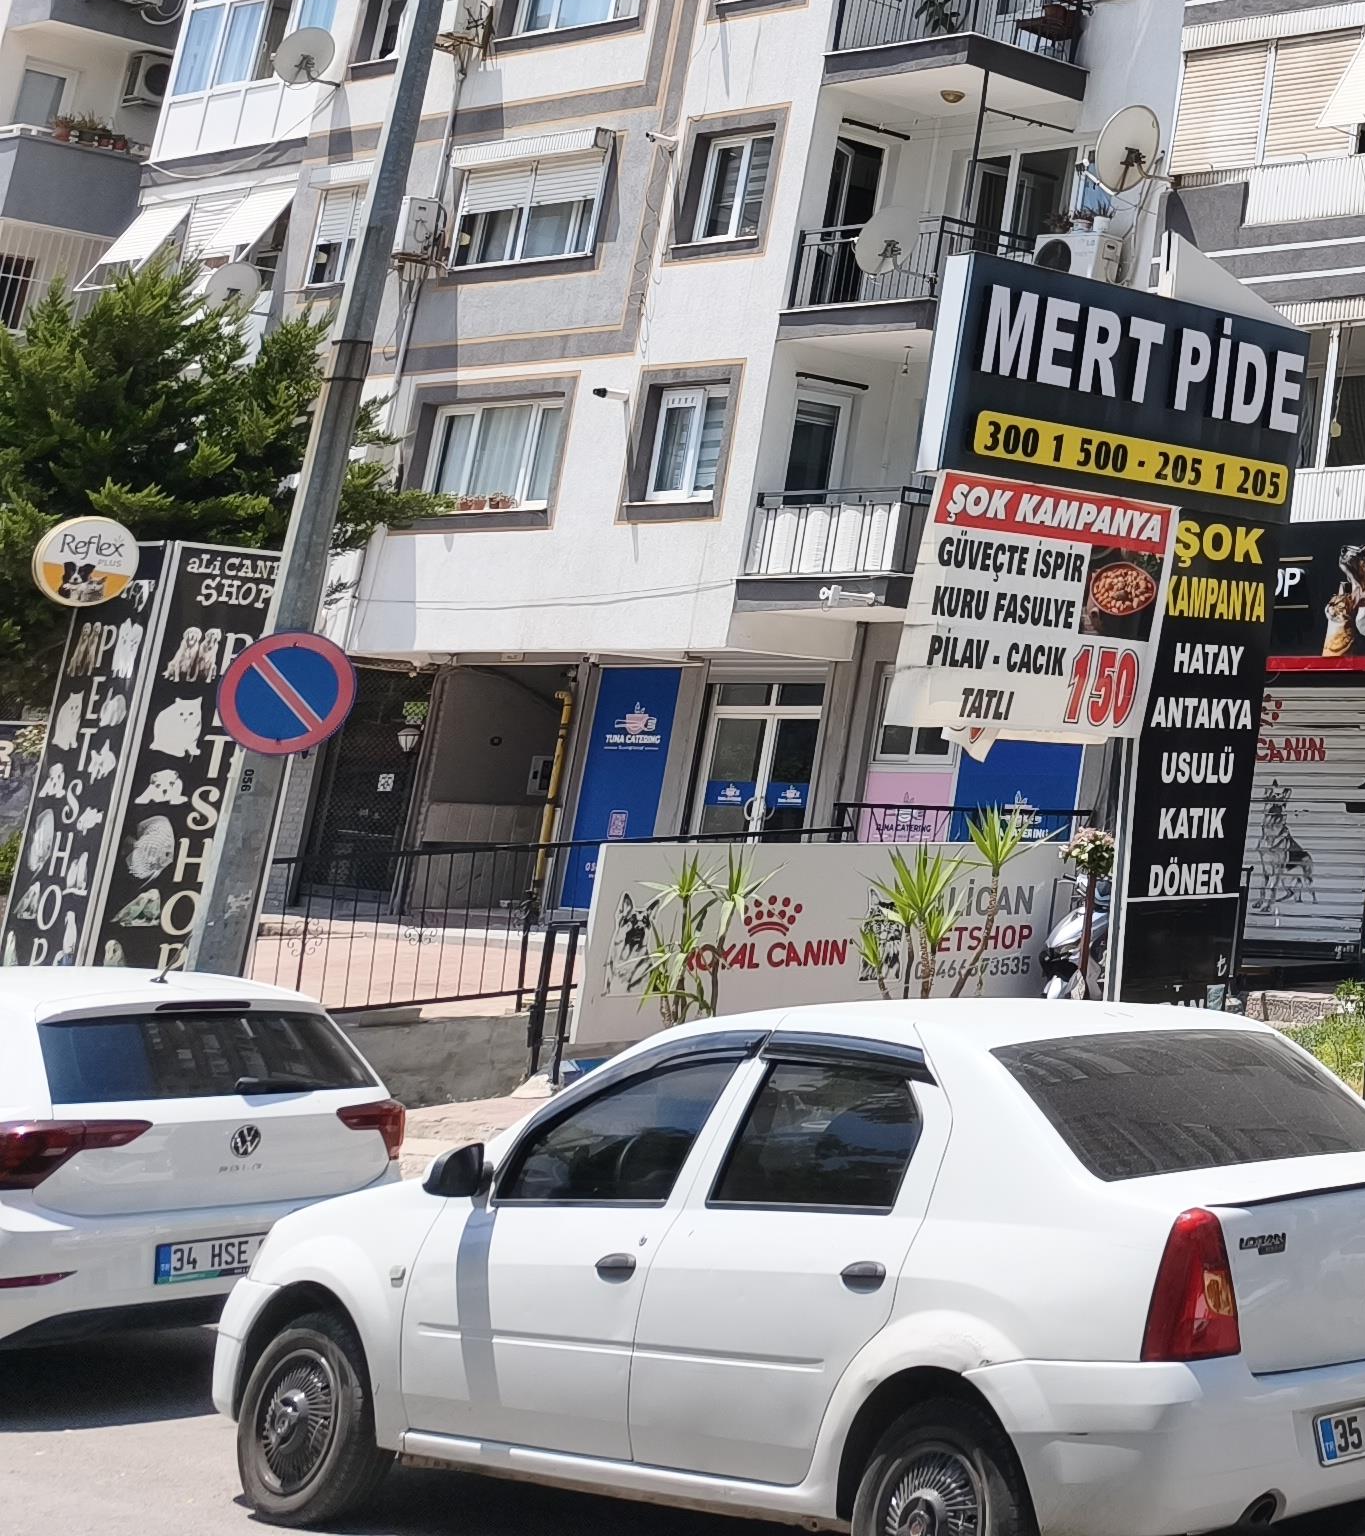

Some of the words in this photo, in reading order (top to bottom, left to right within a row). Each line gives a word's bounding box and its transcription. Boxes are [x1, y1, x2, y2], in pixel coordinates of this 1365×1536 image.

[981, 283, 1165, 405] MERT
[1173, 317, 1305, 434] PİDE
[983, 421, 1039, 458] 300
[1052, 434, 1064, 464] 1
[1077, 437, 1129, 474] 500
[1155, 451, 1203, 487] 205
[1215, 462, 1226, 492] 1
[1236, 465, 1282, 500] 205
[945, 482, 1006, 524] ŞOK
[1018, 491, 1163, 543] KAMPANYA
[60, 533, 125, 560] Reflex
[938, 535, 1028, 588] GÜVEÇTE
[1032, 540, 1085, 584] İSPİR
[1174, 519, 1265, 568] ŞOK
[197, 576, 274, 608] SHOP
[931, 586, 989, 621] KURU
[993, 590, 1075, 631] FASULYE
[1164, 575, 1266, 623] KAMPANYA
[927, 630, 988, 670] PİLAV
[1006, 641, 1067, 678] CACIK
[1173, 642, 1245, 676] HATAY
[958, 687, 1014, 721] TATLI
[1063, 644, 1140, 729] 150
[1150, 696, 1253, 731] ANTAKYA
[1160, 745, 1236, 785] USULÜ
[1158, 807, 1227, 840] KATIK
[1148, 858, 1225, 897] DÖNER
[767, 939, 848, 968] CANIN
[937, 924, 1033, 953] ETSHOP
[173, 1247, 198, 1272] 34
[211, 1240, 249, 1268] HSE
[1333, 1416, 1363, 1453] 35
